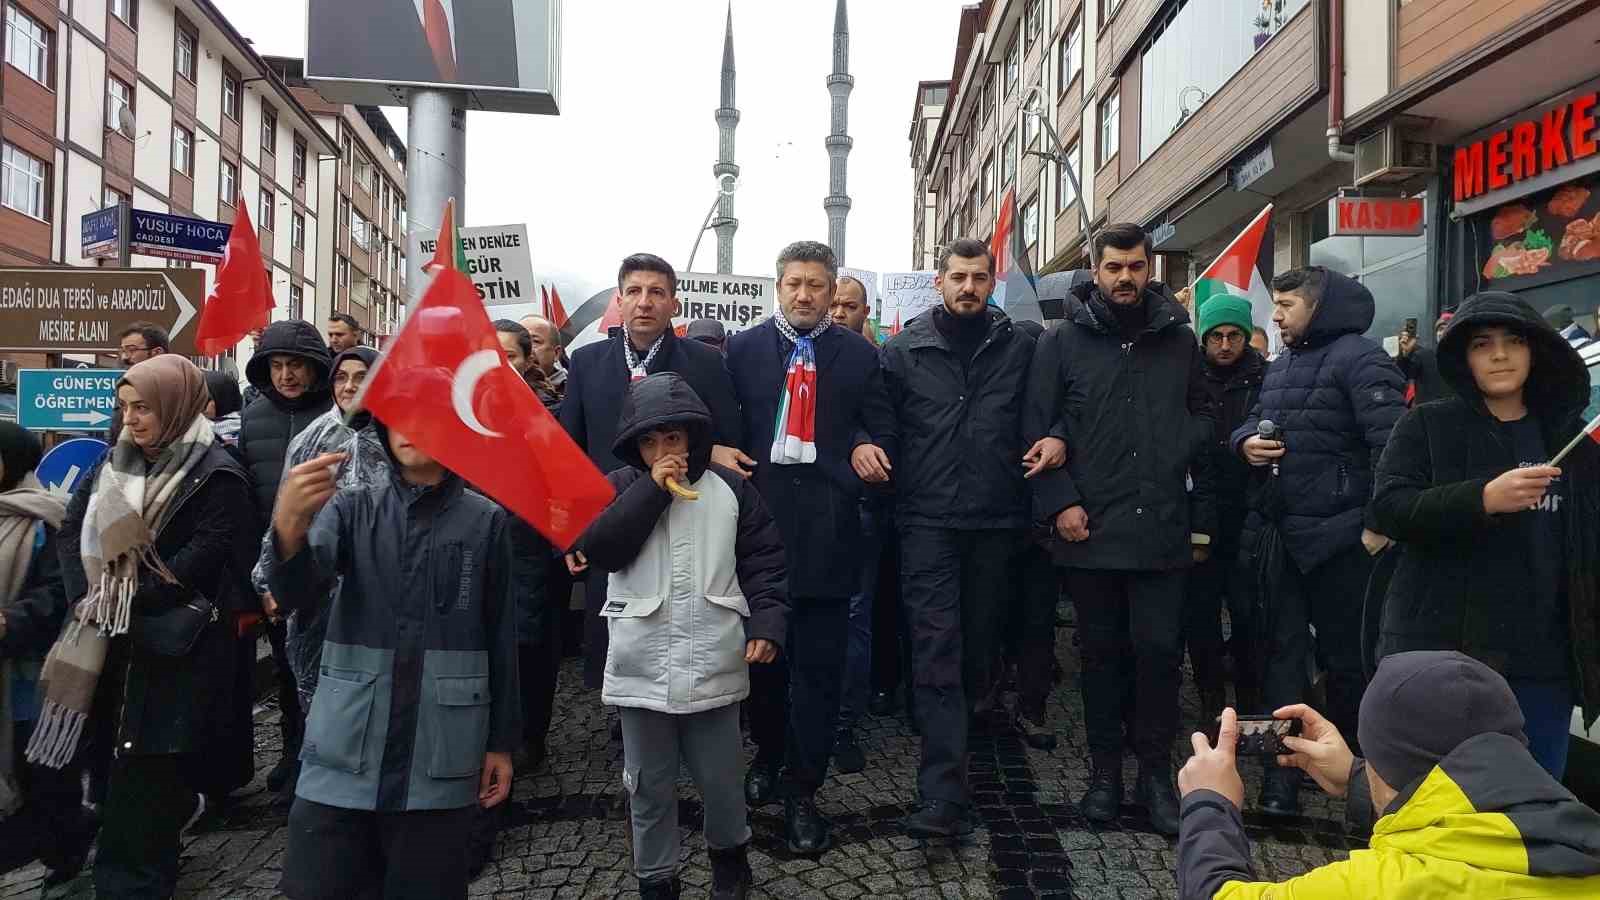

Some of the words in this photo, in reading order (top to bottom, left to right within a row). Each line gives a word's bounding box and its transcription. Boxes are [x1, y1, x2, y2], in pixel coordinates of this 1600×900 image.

[1453, 92, 1598, 203] MERKE
[1339, 201, 1421, 230] KASAP
[136, 216, 183, 235] YUSUF
[187, 224, 225, 242] HOCA
[479, 232, 521, 250] DENİZE
[38, 287, 60, 309] DUA
[63, 283, 95, 310] TEPESİ
[97, 295, 108, 310] ve
[111, 283, 166, 311] ARAPDÜZÜ
[722, 281, 763, 299] KARŞI
[39, 315, 75, 341] MESİRE
[78, 320, 109, 342] ALANI
[34, 393, 116, 409] ÖĞRETMEN
